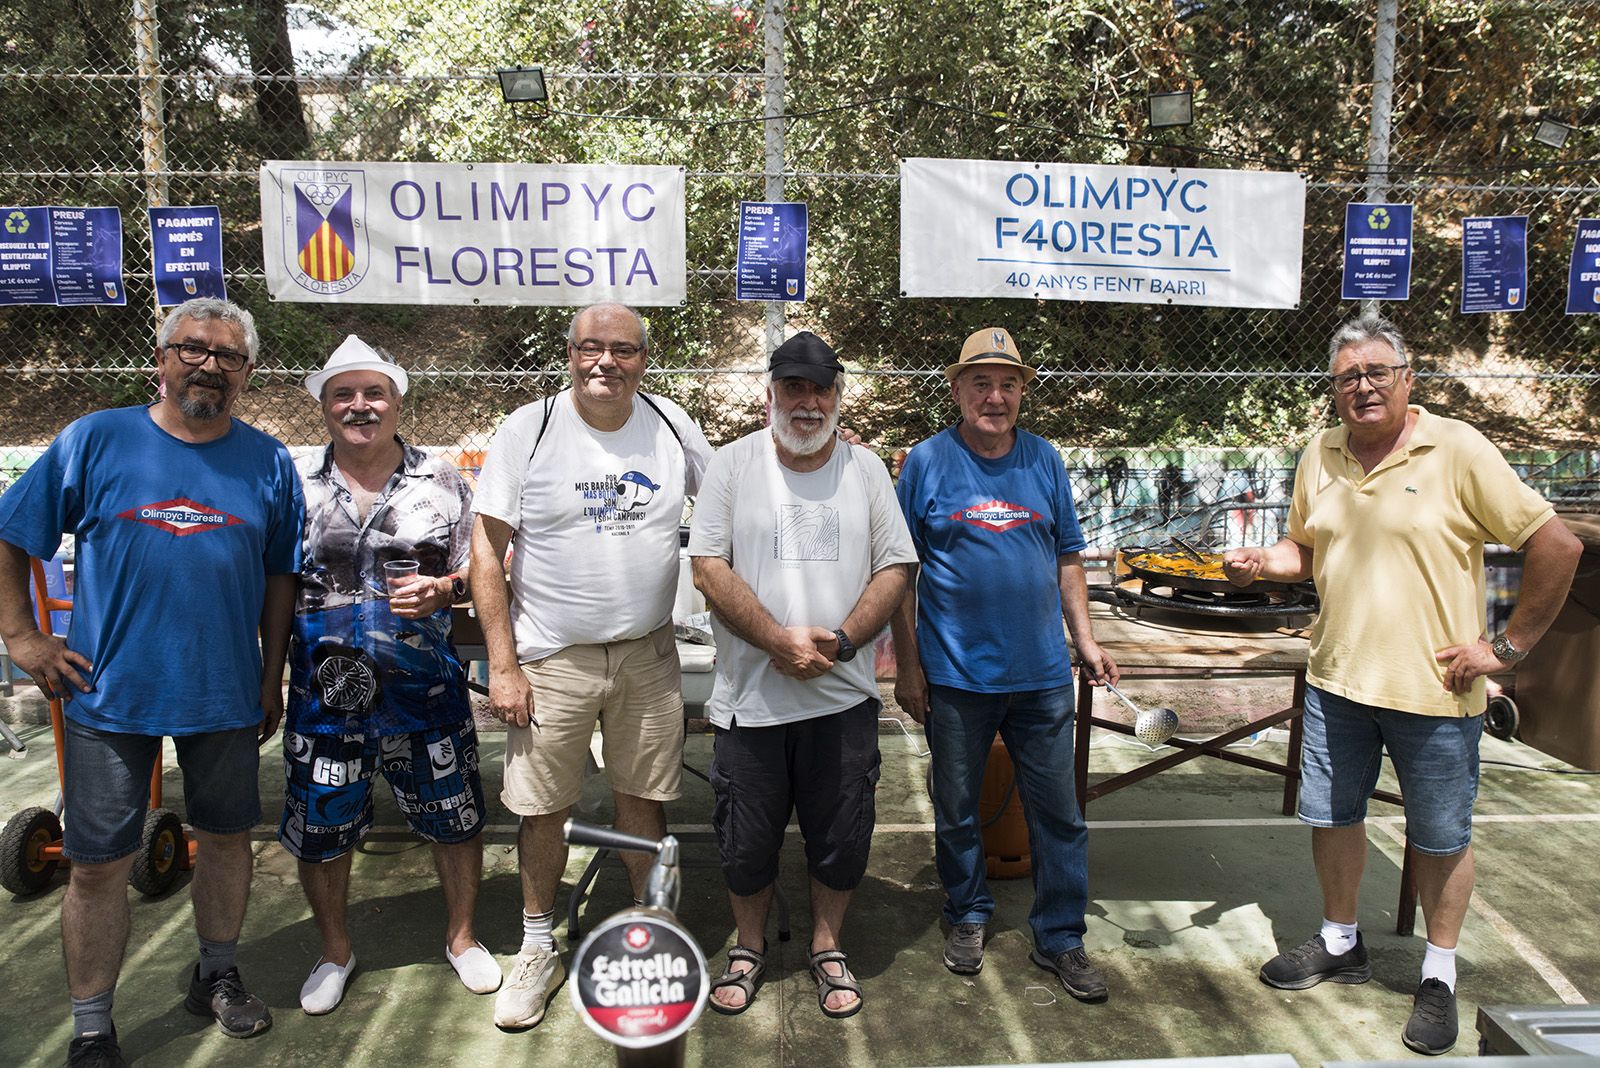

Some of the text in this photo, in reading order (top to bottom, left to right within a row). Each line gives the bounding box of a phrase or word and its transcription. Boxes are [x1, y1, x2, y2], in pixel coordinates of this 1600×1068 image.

[297, 172, 349, 182] OLIMPYC
[1005, 173, 1208, 214] OLIMPYC
[390, 180, 656, 222] OLIMPYC
[53, 210, 85, 219] PREUS
[745, 206, 774, 215] PREUS
[157, 217, 214, 228] PAGAMENT
[1466, 221, 1492, 229] PREUS
[169, 230, 203, 242] NOMÉS
[995, 216, 1218, 258] F40RESTA
[180, 248, 194, 256] EN
[166, 262, 210, 272] EFECTIU!
[394, 246, 659, 287] FLORESTA
[295, 272, 362, 293] FLORESTA
[1005, 271, 1206, 295] 40 ANYS FENT BARRI
[575, 482, 618, 491] MIS BARBAS
[584, 491, 597, 499] MAS
[142, 509, 223, 523] Olimpyc Floresta
[614, 512, 646, 521] CAMPIONS!
[966, 511, 1029, 520] Olimpyc Floresta
[590, 952, 688, 981] Estrella
[594, 977, 686, 1007] Galicia
